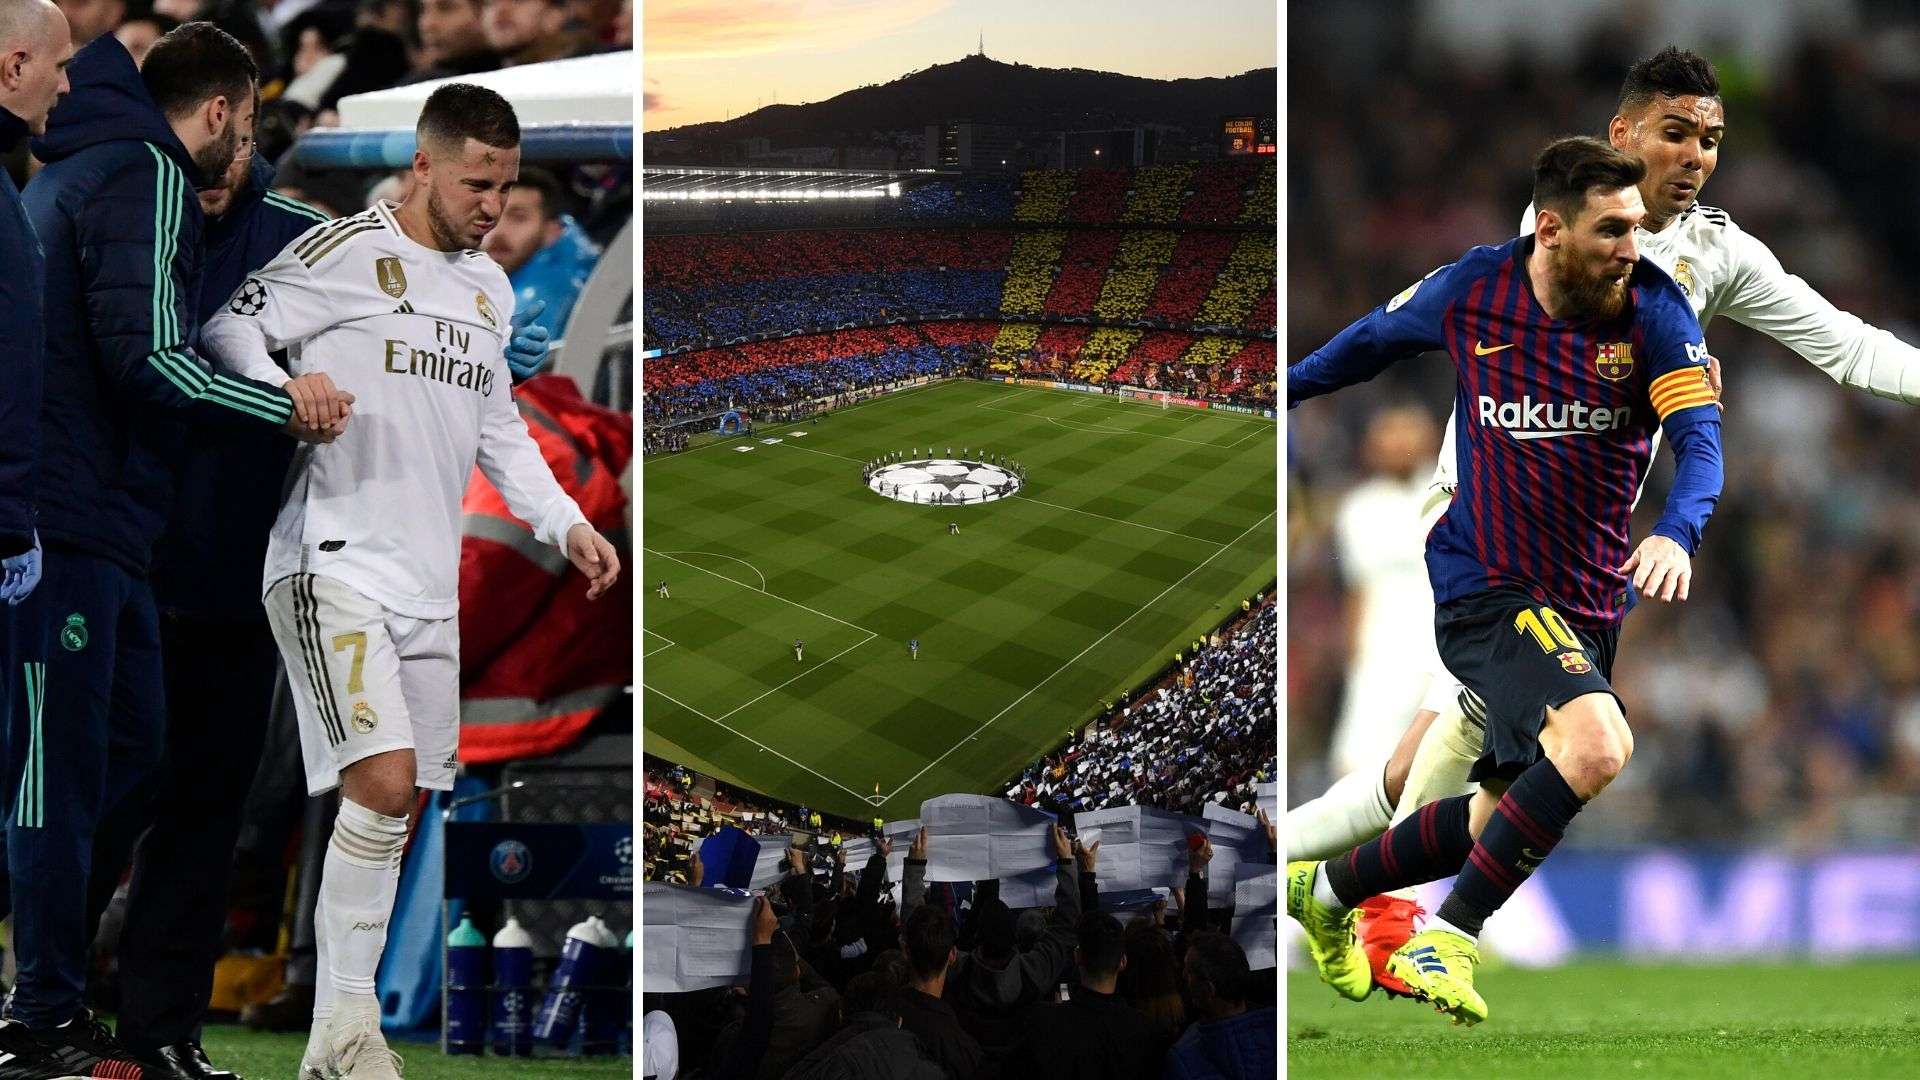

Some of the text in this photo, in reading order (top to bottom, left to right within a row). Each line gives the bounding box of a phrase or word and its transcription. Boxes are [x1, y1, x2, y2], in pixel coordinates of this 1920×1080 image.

[435, 320, 470, 354] Fly
[1212, 402, 1252, 414] Heineken
[1478, 395, 1632, 431] Rakuten
[1513, 606, 1585, 655] 10
[331, 631, 368, 695] 7
